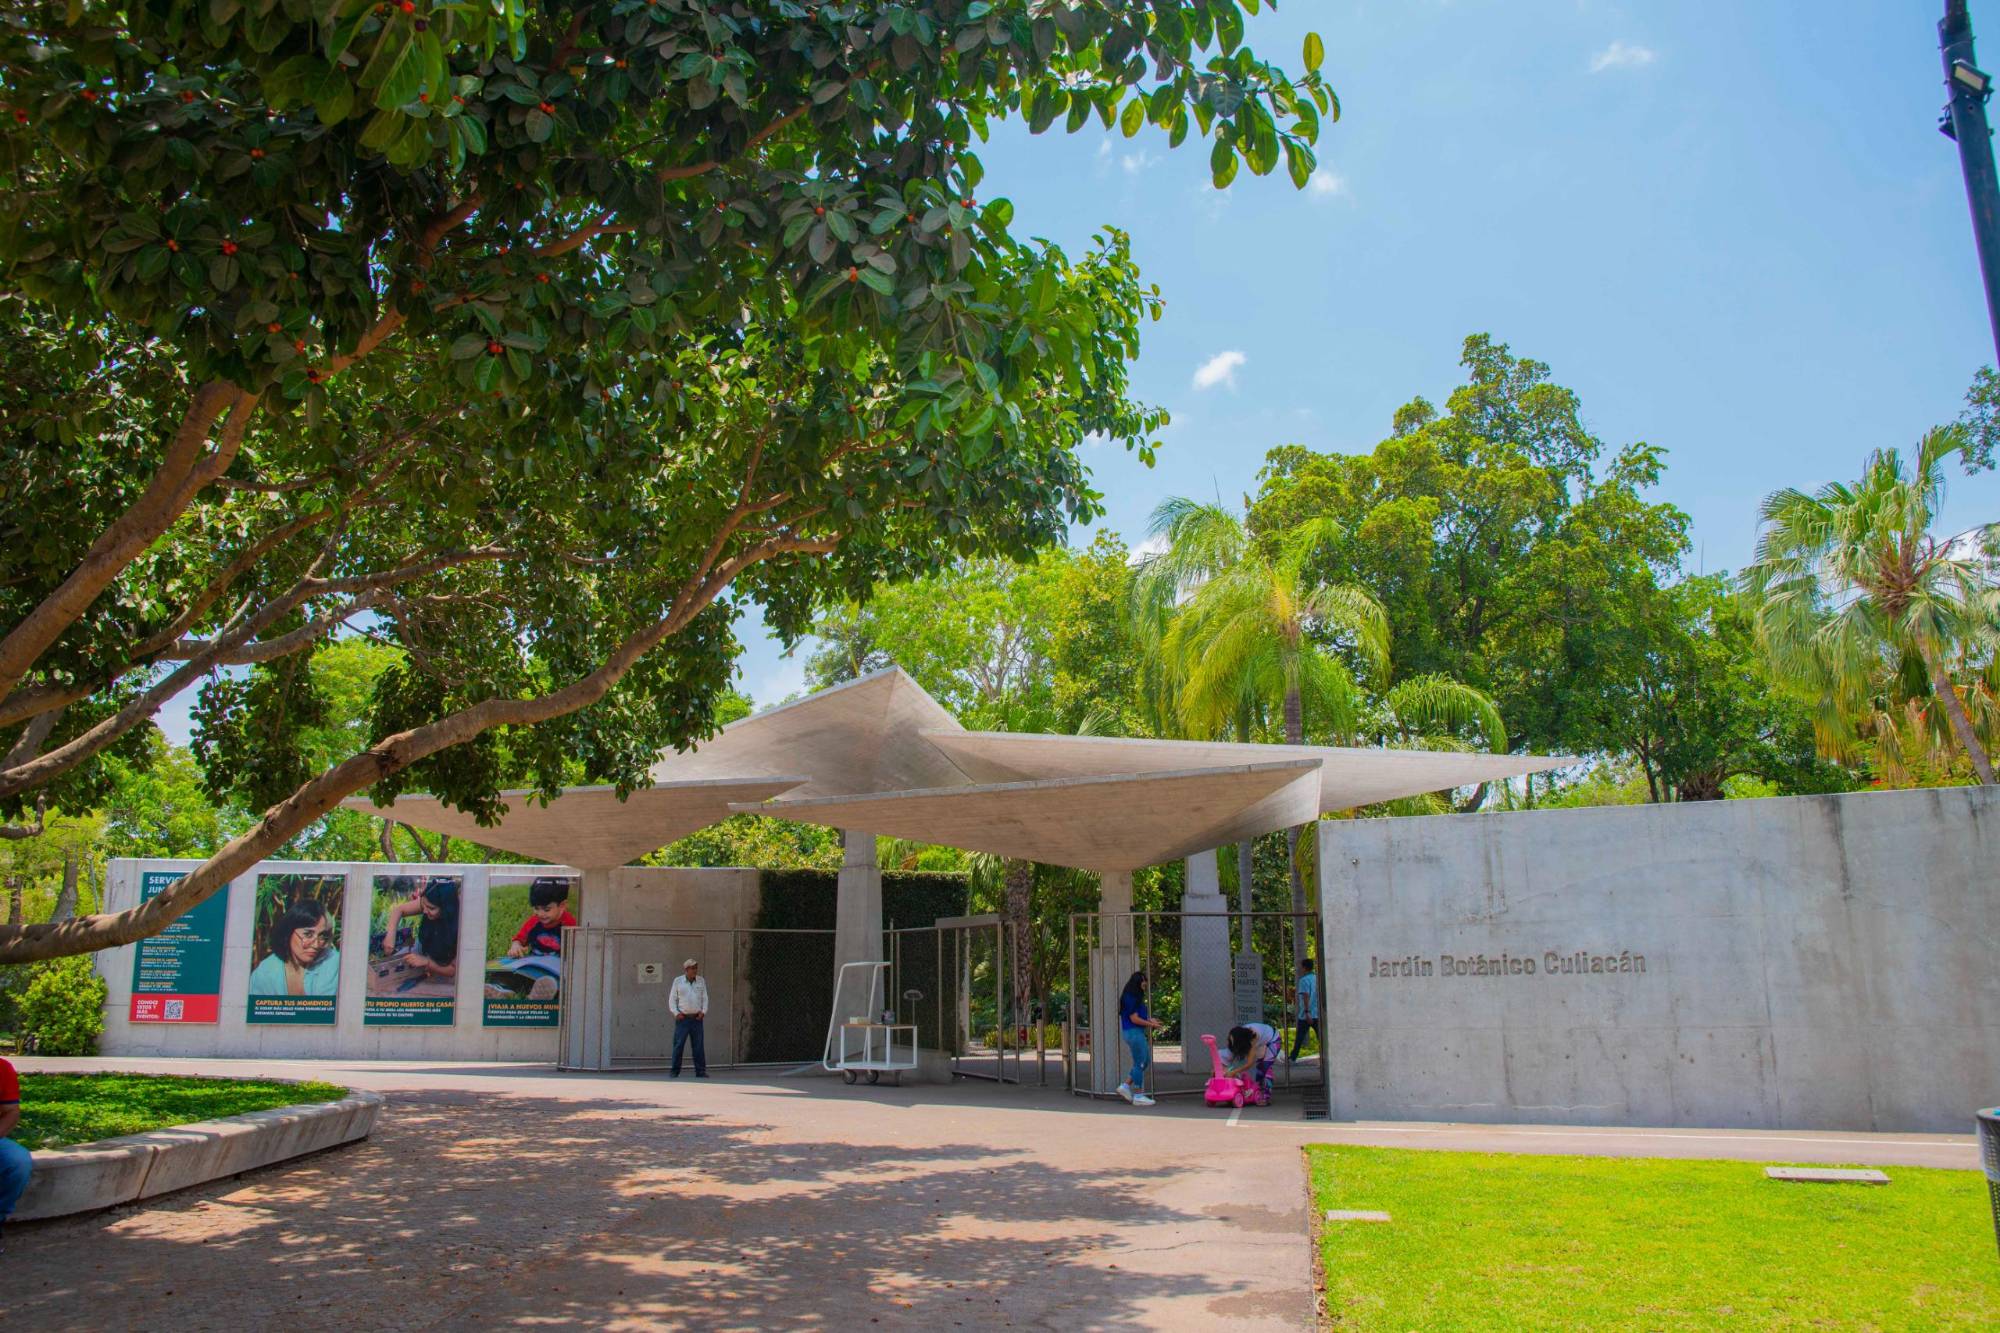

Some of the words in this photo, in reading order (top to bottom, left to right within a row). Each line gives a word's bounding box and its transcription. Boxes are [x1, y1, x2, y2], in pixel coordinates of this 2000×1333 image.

[149, 876, 182, 884] SERVIC
[1369, 955, 1433, 978] Jardín
[1440, 953, 1536, 977] Botánico
[1544, 950, 1647, 975] Culiacán
